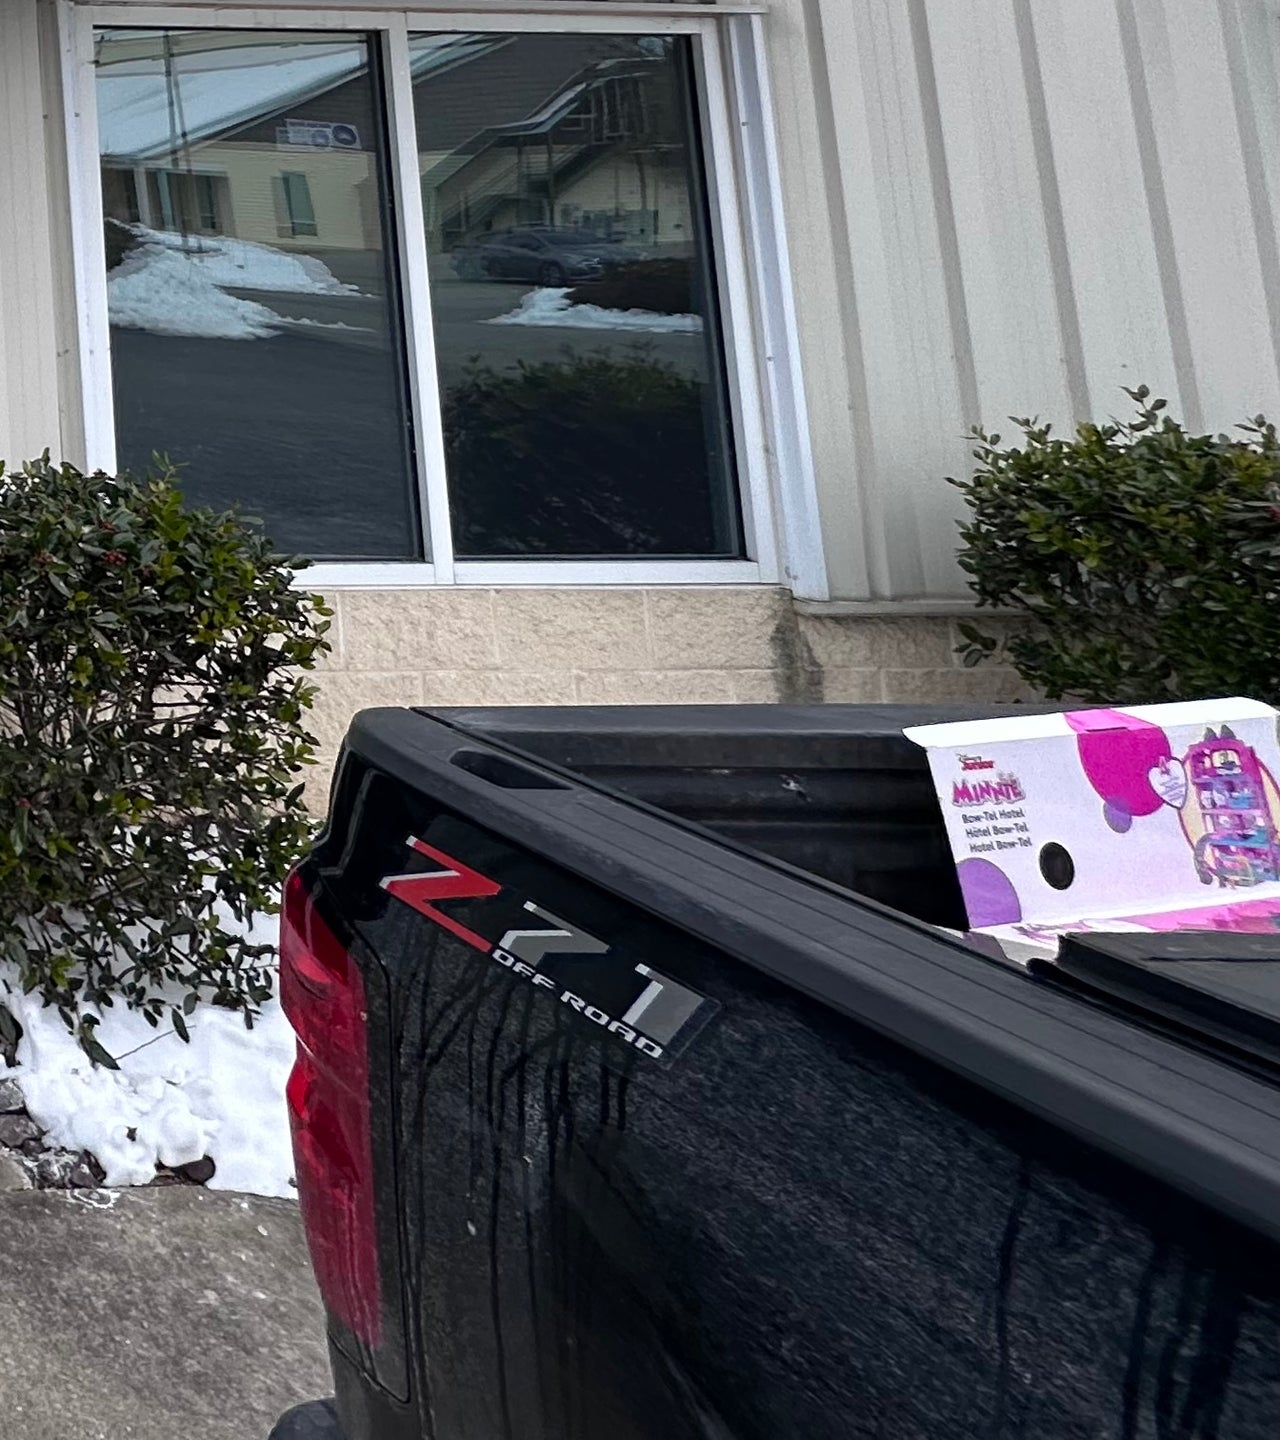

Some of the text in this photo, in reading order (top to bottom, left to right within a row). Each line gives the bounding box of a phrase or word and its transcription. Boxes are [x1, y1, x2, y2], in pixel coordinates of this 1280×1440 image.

[998, 807, 1026, 819] Hotel
[969, 841, 996, 853] Hotel
[379, 834, 705, 1048] Z71
[492, 948, 664, 1059] OFF ROAD
